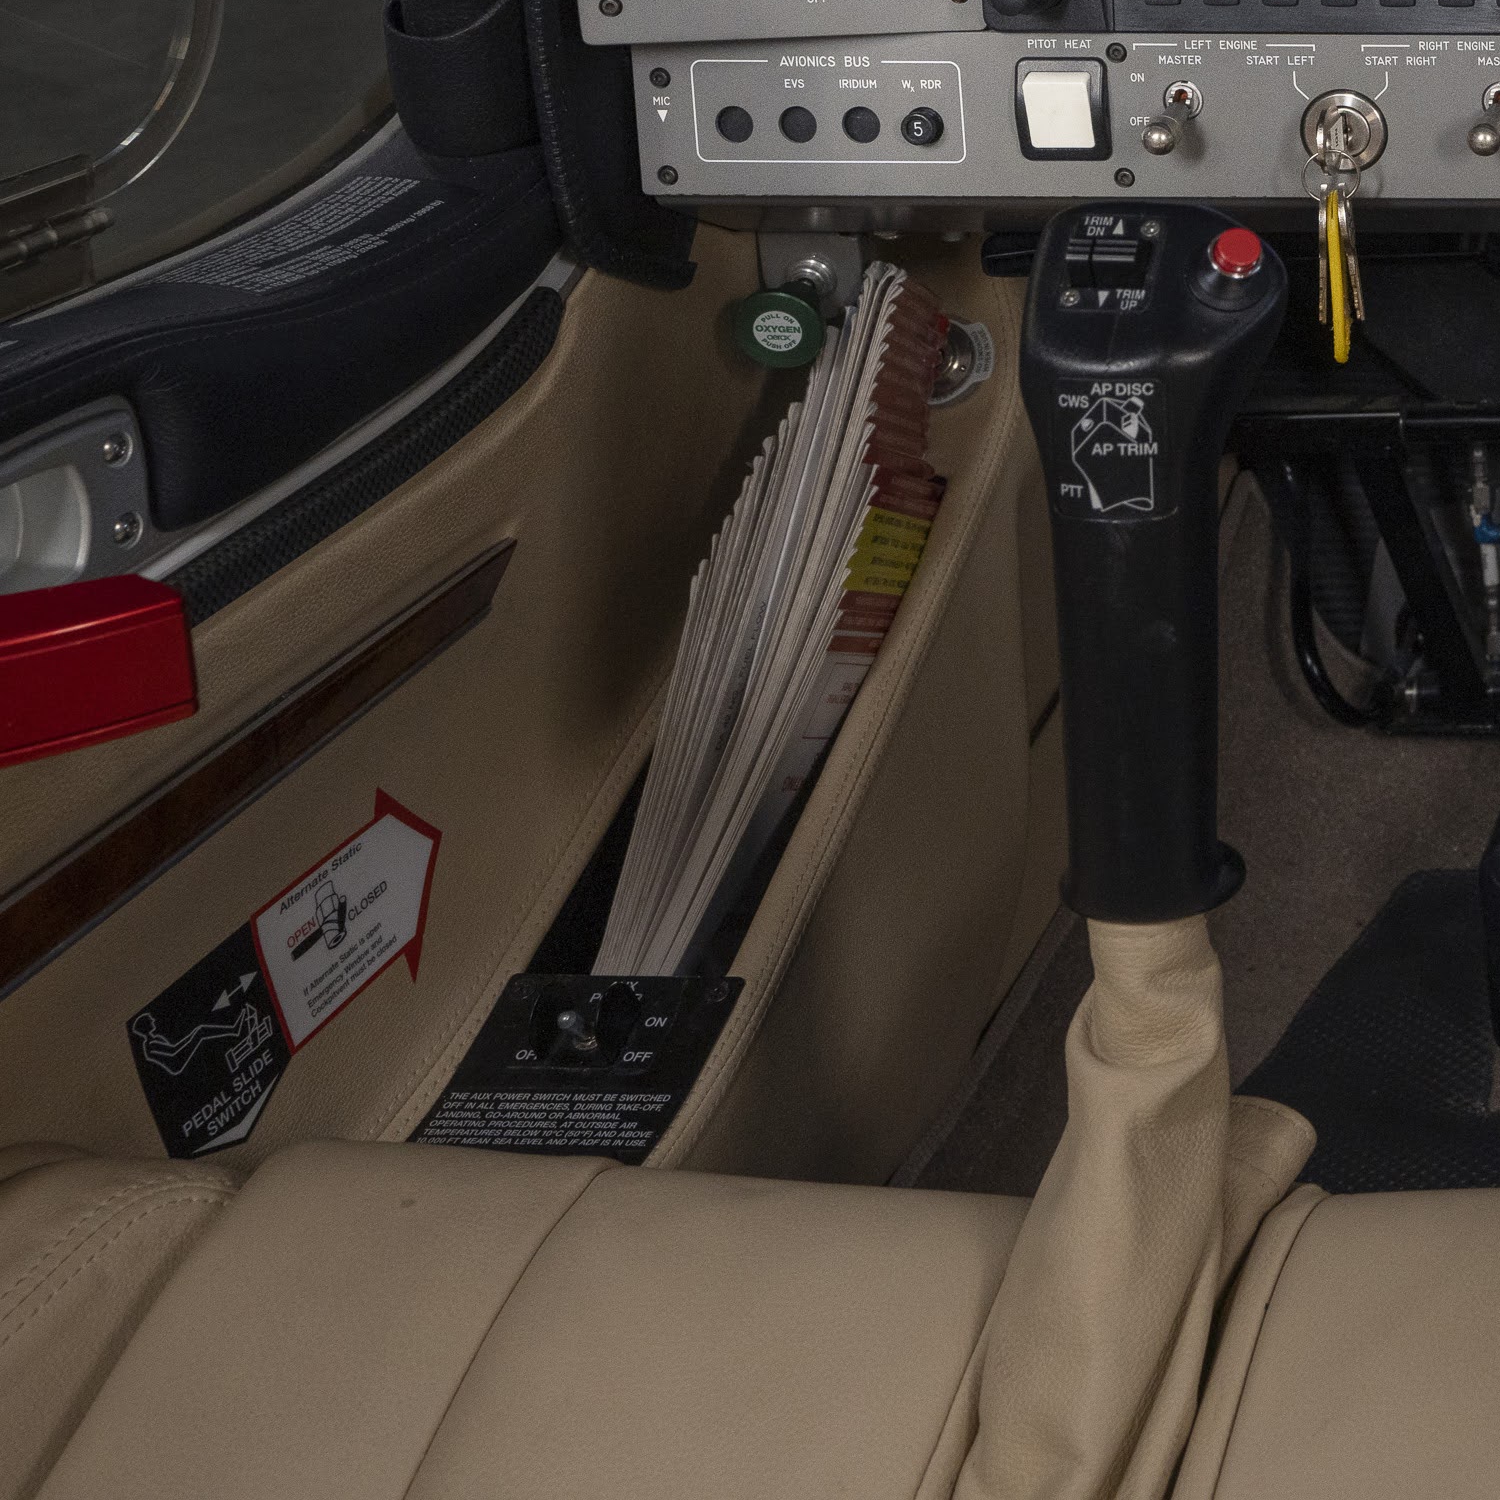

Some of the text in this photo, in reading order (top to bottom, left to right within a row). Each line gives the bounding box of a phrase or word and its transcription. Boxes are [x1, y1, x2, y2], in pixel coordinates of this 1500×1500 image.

[1027, 39, 1091, 49] PITOT HEAT
[1184, 40, 1257, 50] LEFT ENGINE
[779, 56, 870, 68] AVIONICS BUS
[839, 79, 877, 89] IRIDIUM
[755, 325, 801, 334] OXYGEN
[1091, 383, 1153, 395] AP DISC
[1059, 395, 1089, 408] CWS
[1061, 485, 1083, 497] PTT
[279, 841, 363, 915] Alternate Static
[646, 1017, 667, 1027] ON
[183, 1050, 274, 1138] PEDAL SLIDE
[206, 1080, 264, 1136] SWITCH
